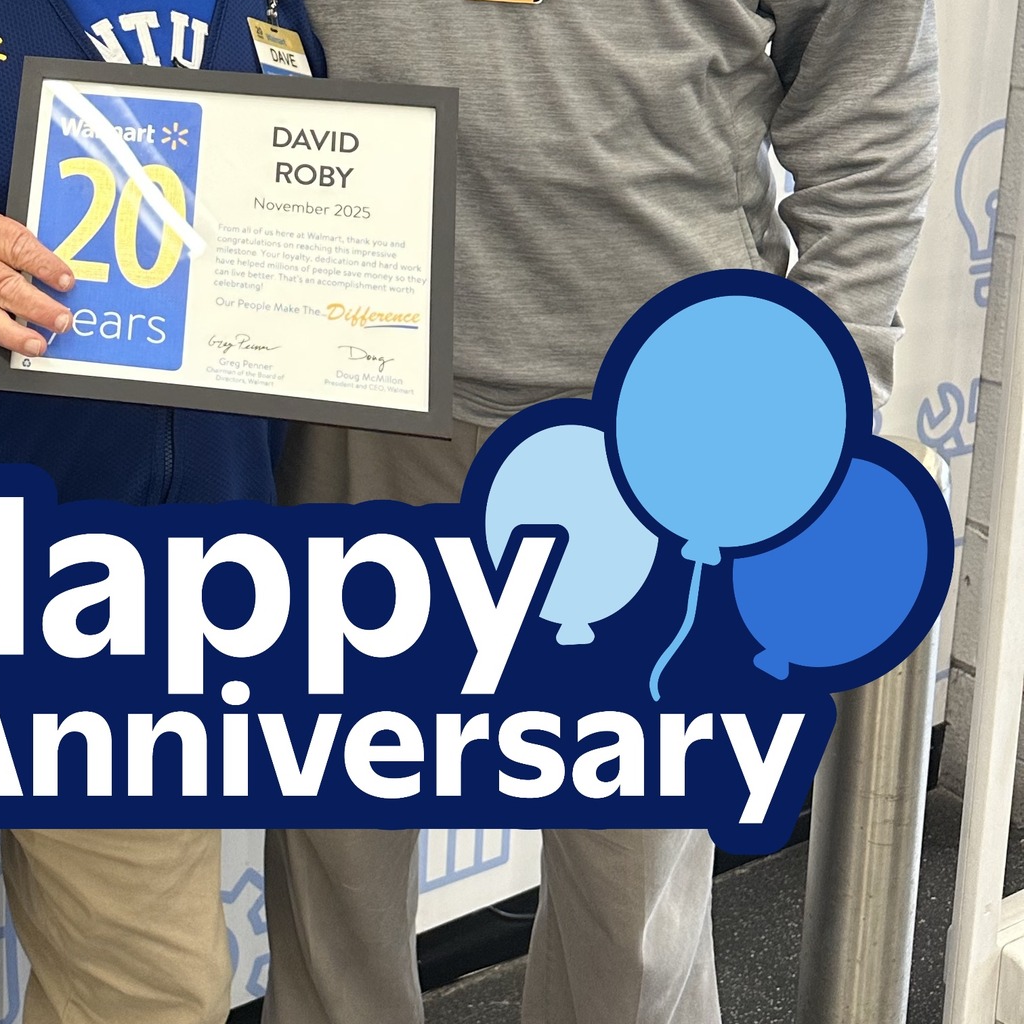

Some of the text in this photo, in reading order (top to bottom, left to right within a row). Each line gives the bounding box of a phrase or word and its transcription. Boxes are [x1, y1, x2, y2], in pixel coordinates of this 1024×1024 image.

[270, 48, 297, 68] DAVE
[272, 126, 360, 154] DAVID
[275, 162, 354, 189] ROBY
[254, 197, 371, 219] November 2025
[53, 157, 187, 289] 20
[218, 223, 240, 233] From
[242, 226, 251, 234] all
[253, 227, 263, 235] of
[276, 229, 294, 238] here
[346, 236, 370, 245] thank
[217, 236, 281, 248] congratulations
[296, 243, 332, 254] reaching
[335, 246, 349, 254] this
[352, 248, 397, 259] impressive
[216, 256, 235, 265] have
[237, 258, 265, 269] helped
[267, 262, 299, 272] millions
[312, 267, 341, 276] people
[343, 270, 362, 278] save
[364, 272, 393, 282] money
[407, 275, 428, 286] they
[261, 249, 280, 258] Your
[315, 255, 359, 266] dedication
[361, 260, 376, 268] and
[379, 261, 398, 270] hard
[400, 264, 421, 272] work
[214, 268, 229, 276] can
[231, 269, 246, 277] live
[317, 278, 387, 292] accomplishment
[389, 286, 415, 294] worth
[215, 296, 235, 307] Our
[237, 298, 271, 311] People
[273, 302, 300, 314] Make
[326, 303, 421, 327] Difference
[48, 308, 167, 345] ears
[219, 357, 273, 370] Greg Penner
[336, 370, 403, 385] Doug McMillon
